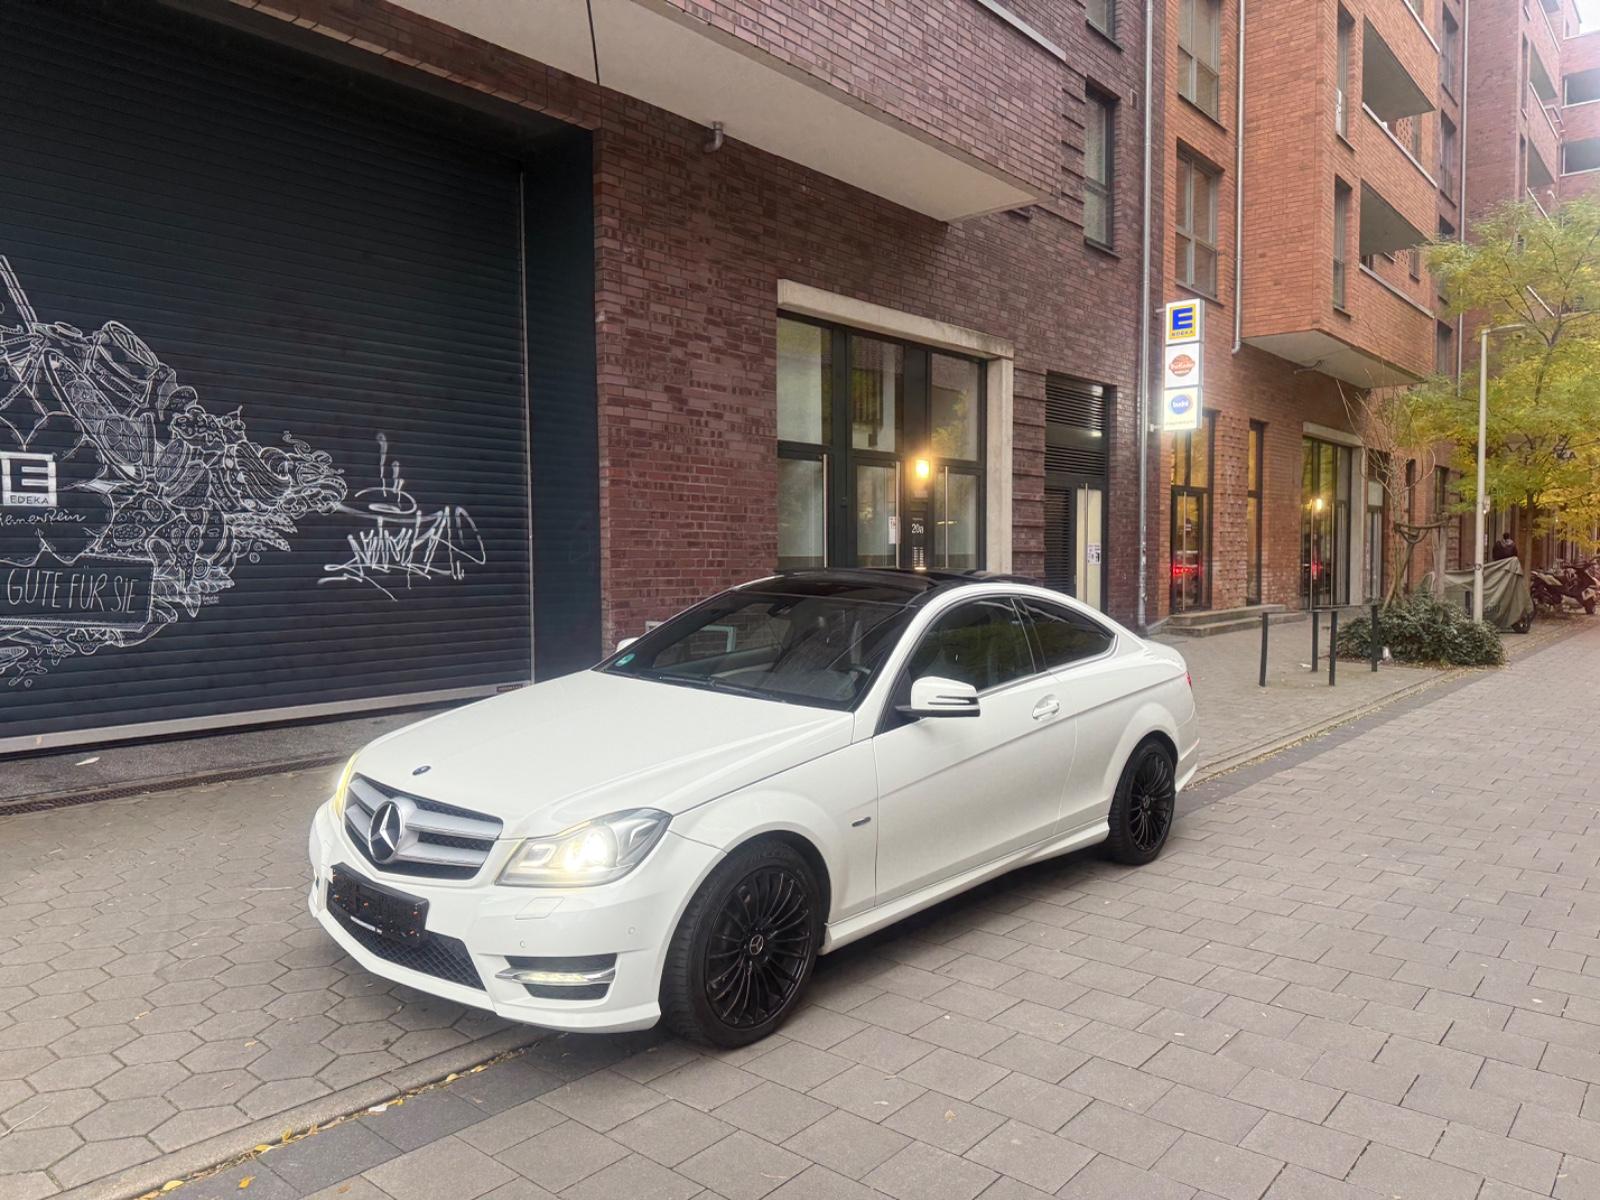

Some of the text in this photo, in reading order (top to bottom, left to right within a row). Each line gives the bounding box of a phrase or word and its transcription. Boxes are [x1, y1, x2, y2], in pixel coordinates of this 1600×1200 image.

[1172, 306, 1193, 331] E
[10, 494, 49, 505] EDEKA
[911, 523, 924, 534] 20a
[8, 564, 139, 613] GUTE FÜR SIE
